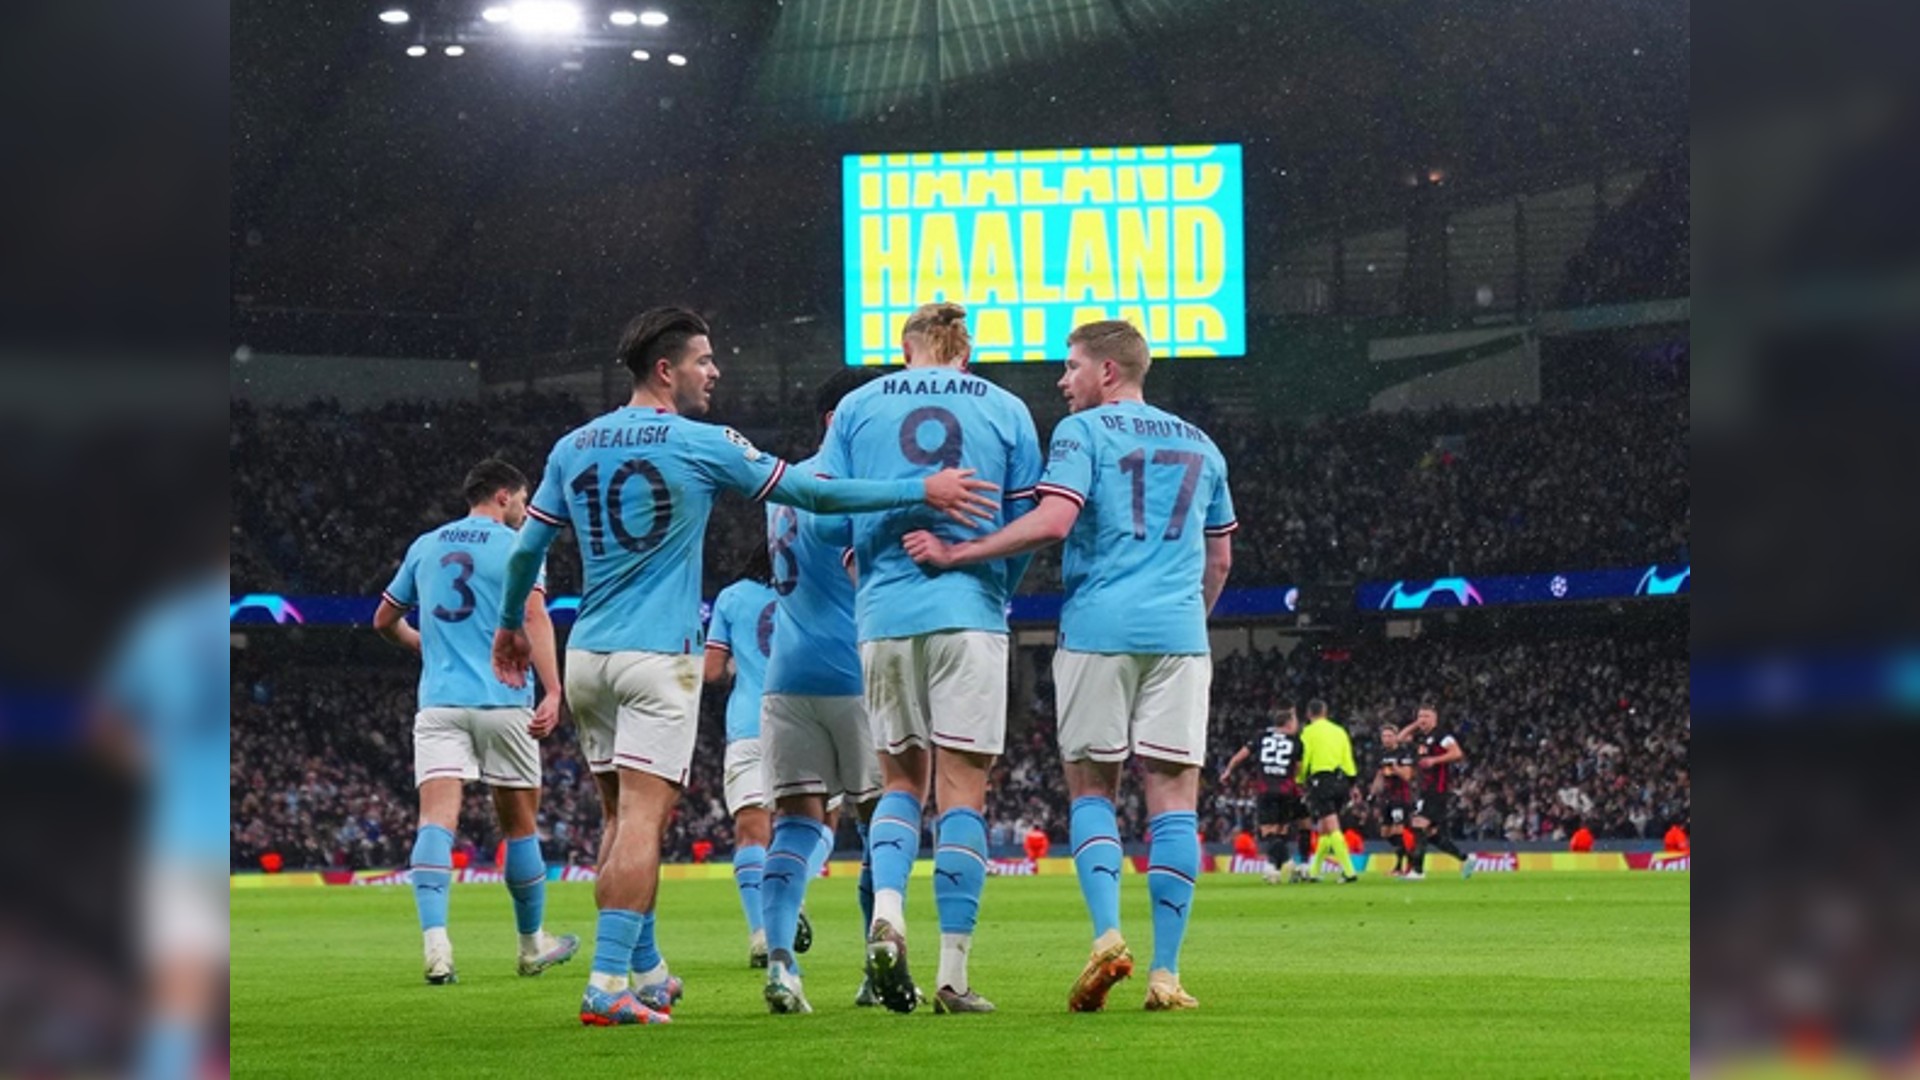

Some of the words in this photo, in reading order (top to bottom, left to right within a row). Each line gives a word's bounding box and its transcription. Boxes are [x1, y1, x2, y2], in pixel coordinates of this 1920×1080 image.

[861, 205, 1226, 306] HAALAND
[883, 379, 988, 398] HAALAND
[574, 424, 670, 450] GREALISH
[899, 406, 963, 472] 9
[1100, 415, 1129, 434] DE
[571, 458, 672, 557] 10
[1118, 447, 1204, 542] 17
[432, 551, 477, 623] 3
[1261, 736, 1294, 766] 22
